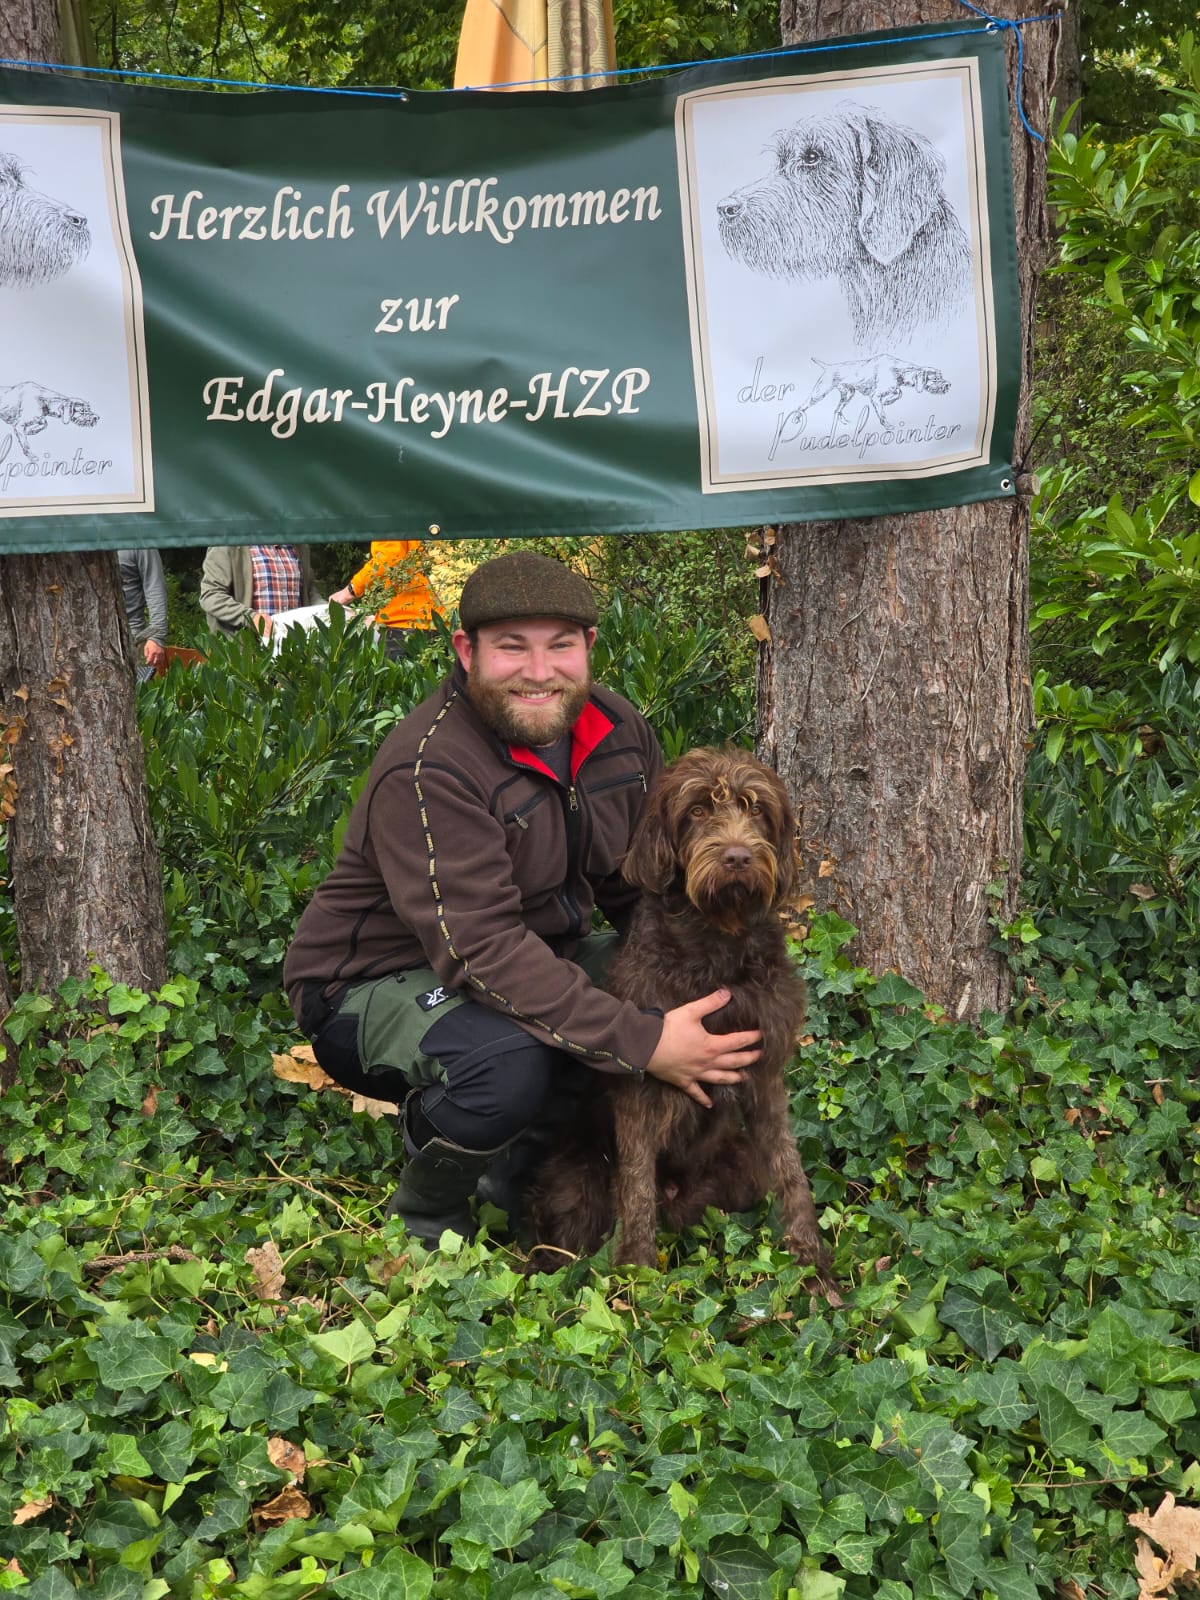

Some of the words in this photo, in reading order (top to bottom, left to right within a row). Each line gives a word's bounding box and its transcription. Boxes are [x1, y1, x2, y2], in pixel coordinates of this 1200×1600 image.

[149, 184, 355, 241] Herzlich
[366, 177, 663, 244] Willkommen
[374, 294, 460, 333] zur
[202, 367, 651, 439] Edgar-Heyne-HZP
[737, 356, 795, 402] der
[767, 405, 961, 461] Pudelpointer
